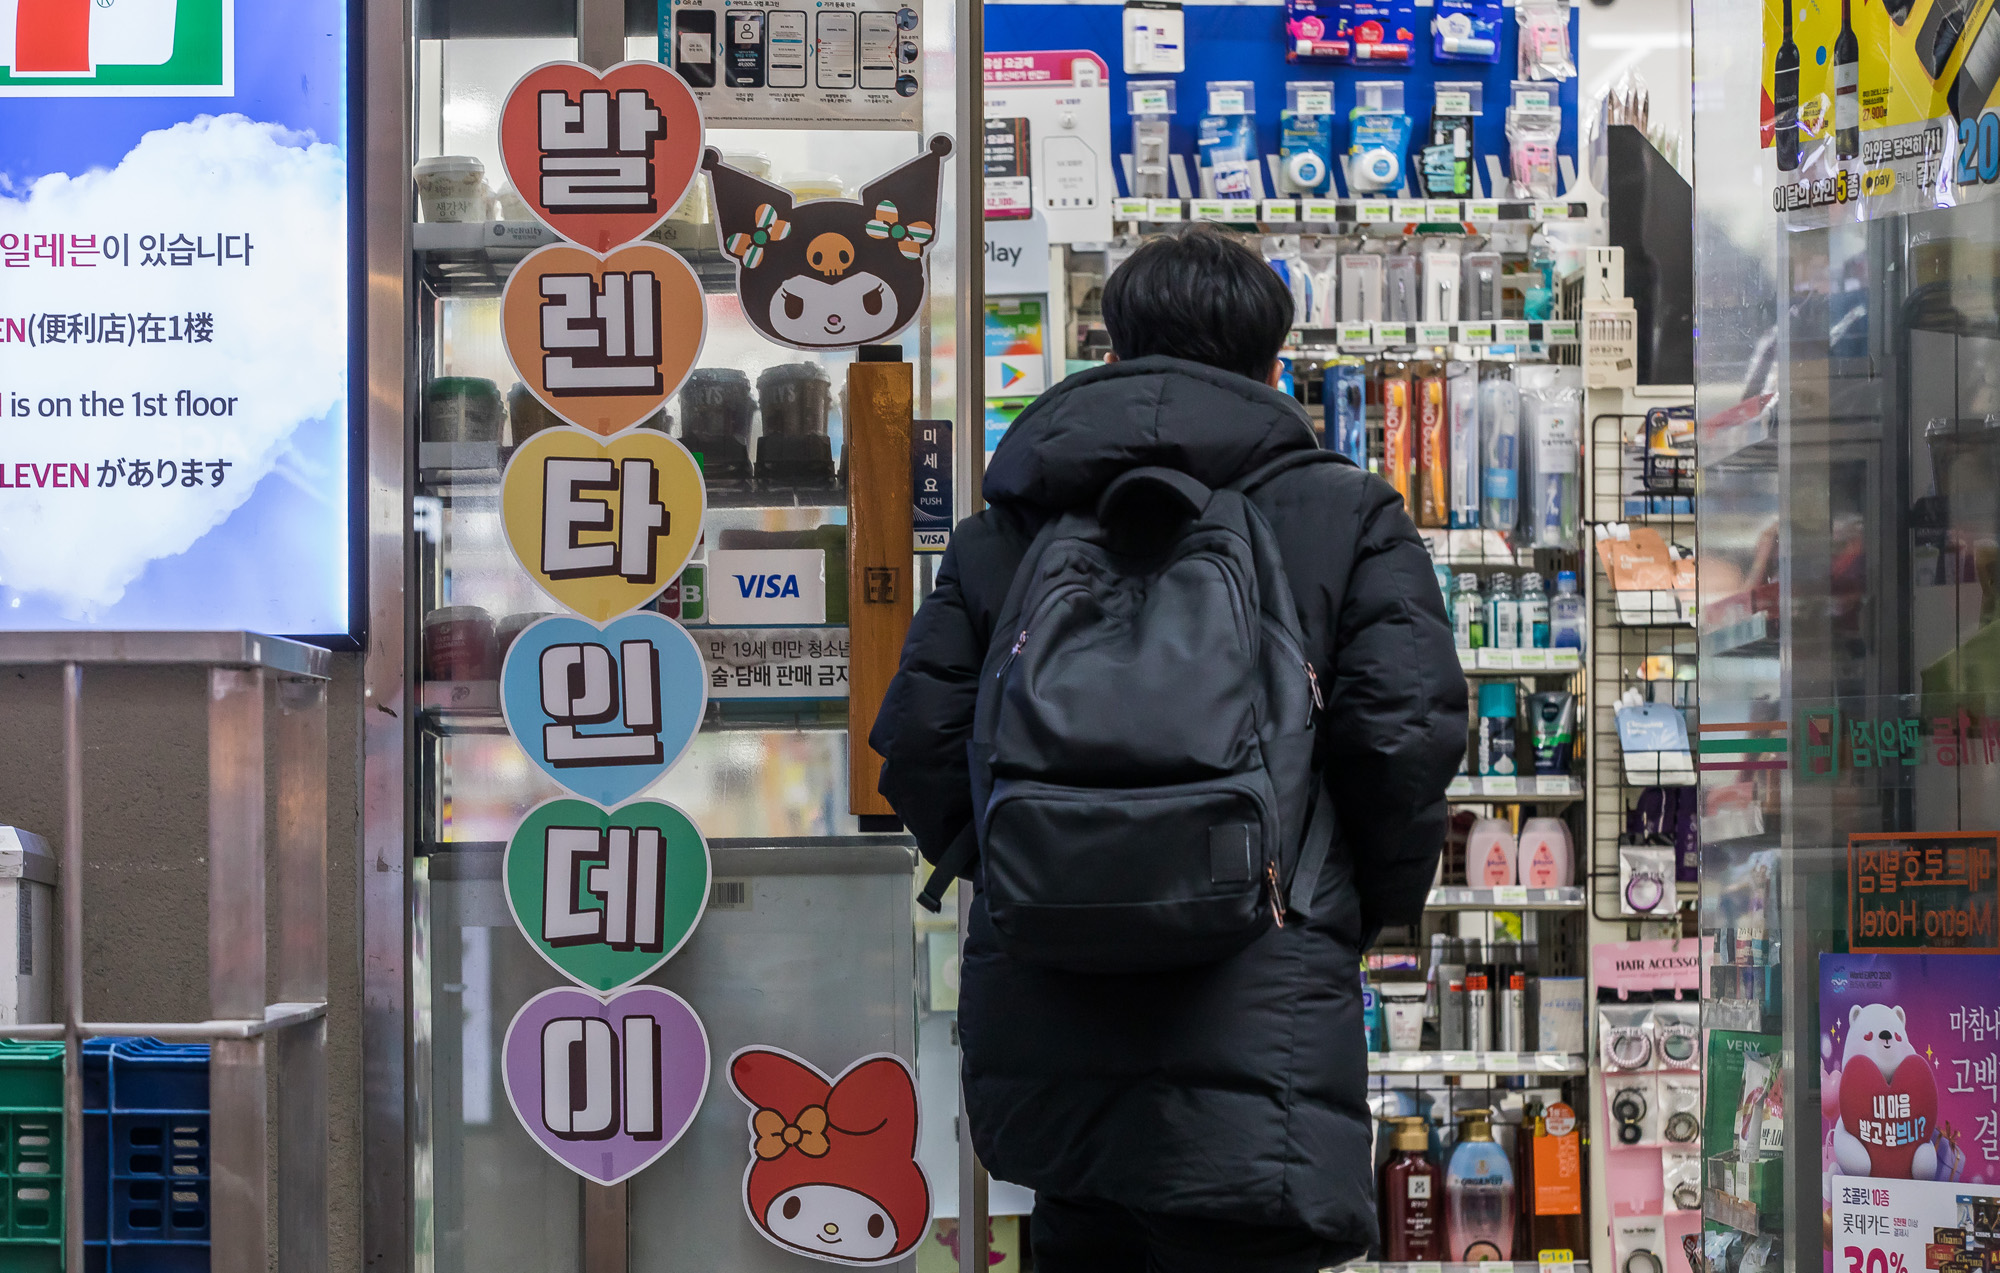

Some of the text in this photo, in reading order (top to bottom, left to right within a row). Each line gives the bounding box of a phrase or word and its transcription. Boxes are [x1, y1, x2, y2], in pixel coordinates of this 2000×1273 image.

[1862, 142, 1893, 165] 와인은
[1893, 135, 1923, 159] 당연히
[1874, 173, 1890, 187] pay
[1773, 186, 1786, 212] 이
[1787, 182, 1811, 210] 달의
[1812, 178, 1837, 207] 와인
[507, 226, 542, 236] McNulty
[0, 233, 254, 268] 일레븐이 있습니다
[11, 390, 238, 417] is on the 1st floor
[923, 428, 939, 492] 미세요
[97, 458, 233, 488] があります
[920, 497, 942, 505] PUSH
[918, 534, 946, 544] VISA
[731, 574, 800, 599] VISA
[710, 641, 726, 659] 만
[732, 641, 767, 659] 19세
[773, 640, 803, 658] 미만
[776, 665, 812, 687] 판매
[1616, 957, 1699, 971] HAIR ACCESSO
[1726, 1040, 1760, 1053] VENY
[1873, 1094, 1911, 1119] 내 마음
[1859, 1119, 1883, 1145] 받고
[1842, 1187, 1889, 1207] 초콜릿 10종
[1843, 1213, 1890, 1235] 롯데카드
[1937, 1232, 1963, 1245] Ghana
